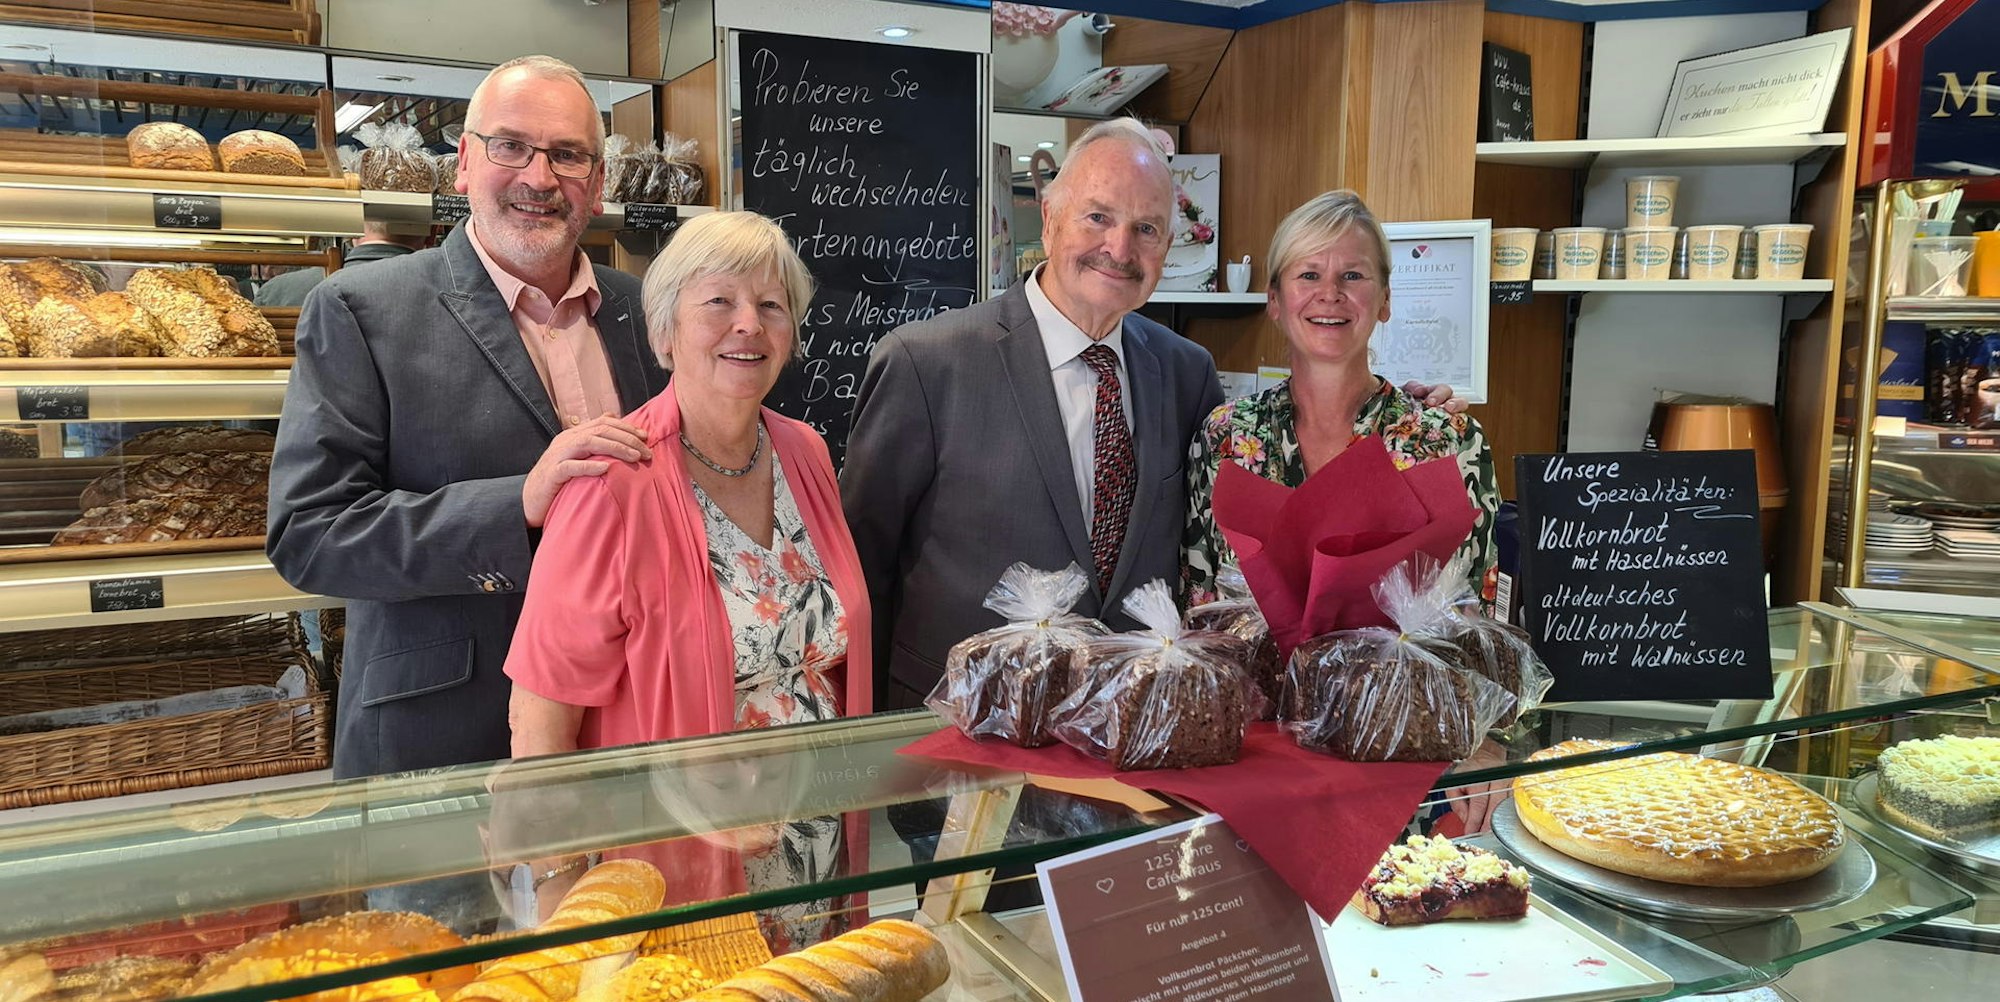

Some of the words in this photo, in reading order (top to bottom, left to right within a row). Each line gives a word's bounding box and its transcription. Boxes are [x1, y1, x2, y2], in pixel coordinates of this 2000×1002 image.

[753, 48, 874, 106] Probieren
[884, 69, 921, 99] Sie
[1737, 77, 1769, 93] macht
[1770, 72, 1798, 87] nicht
[809, 112, 885, 135] unsere
[752, 138, 859, 192] täglich
[811, 168, 971, 207] wechselnden
[827, 332, 876, 357] nich
[802, 358, 858, 402] Ba
[1542, 455, 1621, 483] Unsere
[1577, 475, 1735, 514] Spezialitäten:
[1537, 510, 1670, 551] Vollkornbrot
[1571, 550, 1600, 570] mit
[1604, 544, 1730, 571] Haselnüssen
[1541, 579, 1679, 609] altdeutsches
[1543, 609, 1688, 643] Vollkornbrot
[1581, 644, 1619, 667] mit
[1145, 852, 1174, 872] 125
[1180, 860, 1222, 879] raus
[1146, 921, 1166, 935] Für
[1169, 913, 1189, 928] nur
[1191, 906, 1214, 921] 125
[1214, 895, 1245, 914] Cent!
[1181, 933, 1219, 953] Angebot
[1157, 960, 1216, 986] Vollkornbrot
[1163, 984, 1182, 998] mit
[1181, 973, 1219, 992] unseren
[1220, 961, 1251, 979] beiden
[1251, 944, 1302, 968] Vollkornbrot
[1240, 961, 1293, 985] Vollkornbrot
[1294, 954, 1310, 966] und
[1250, 973, 1297, 996] Hausrezept
